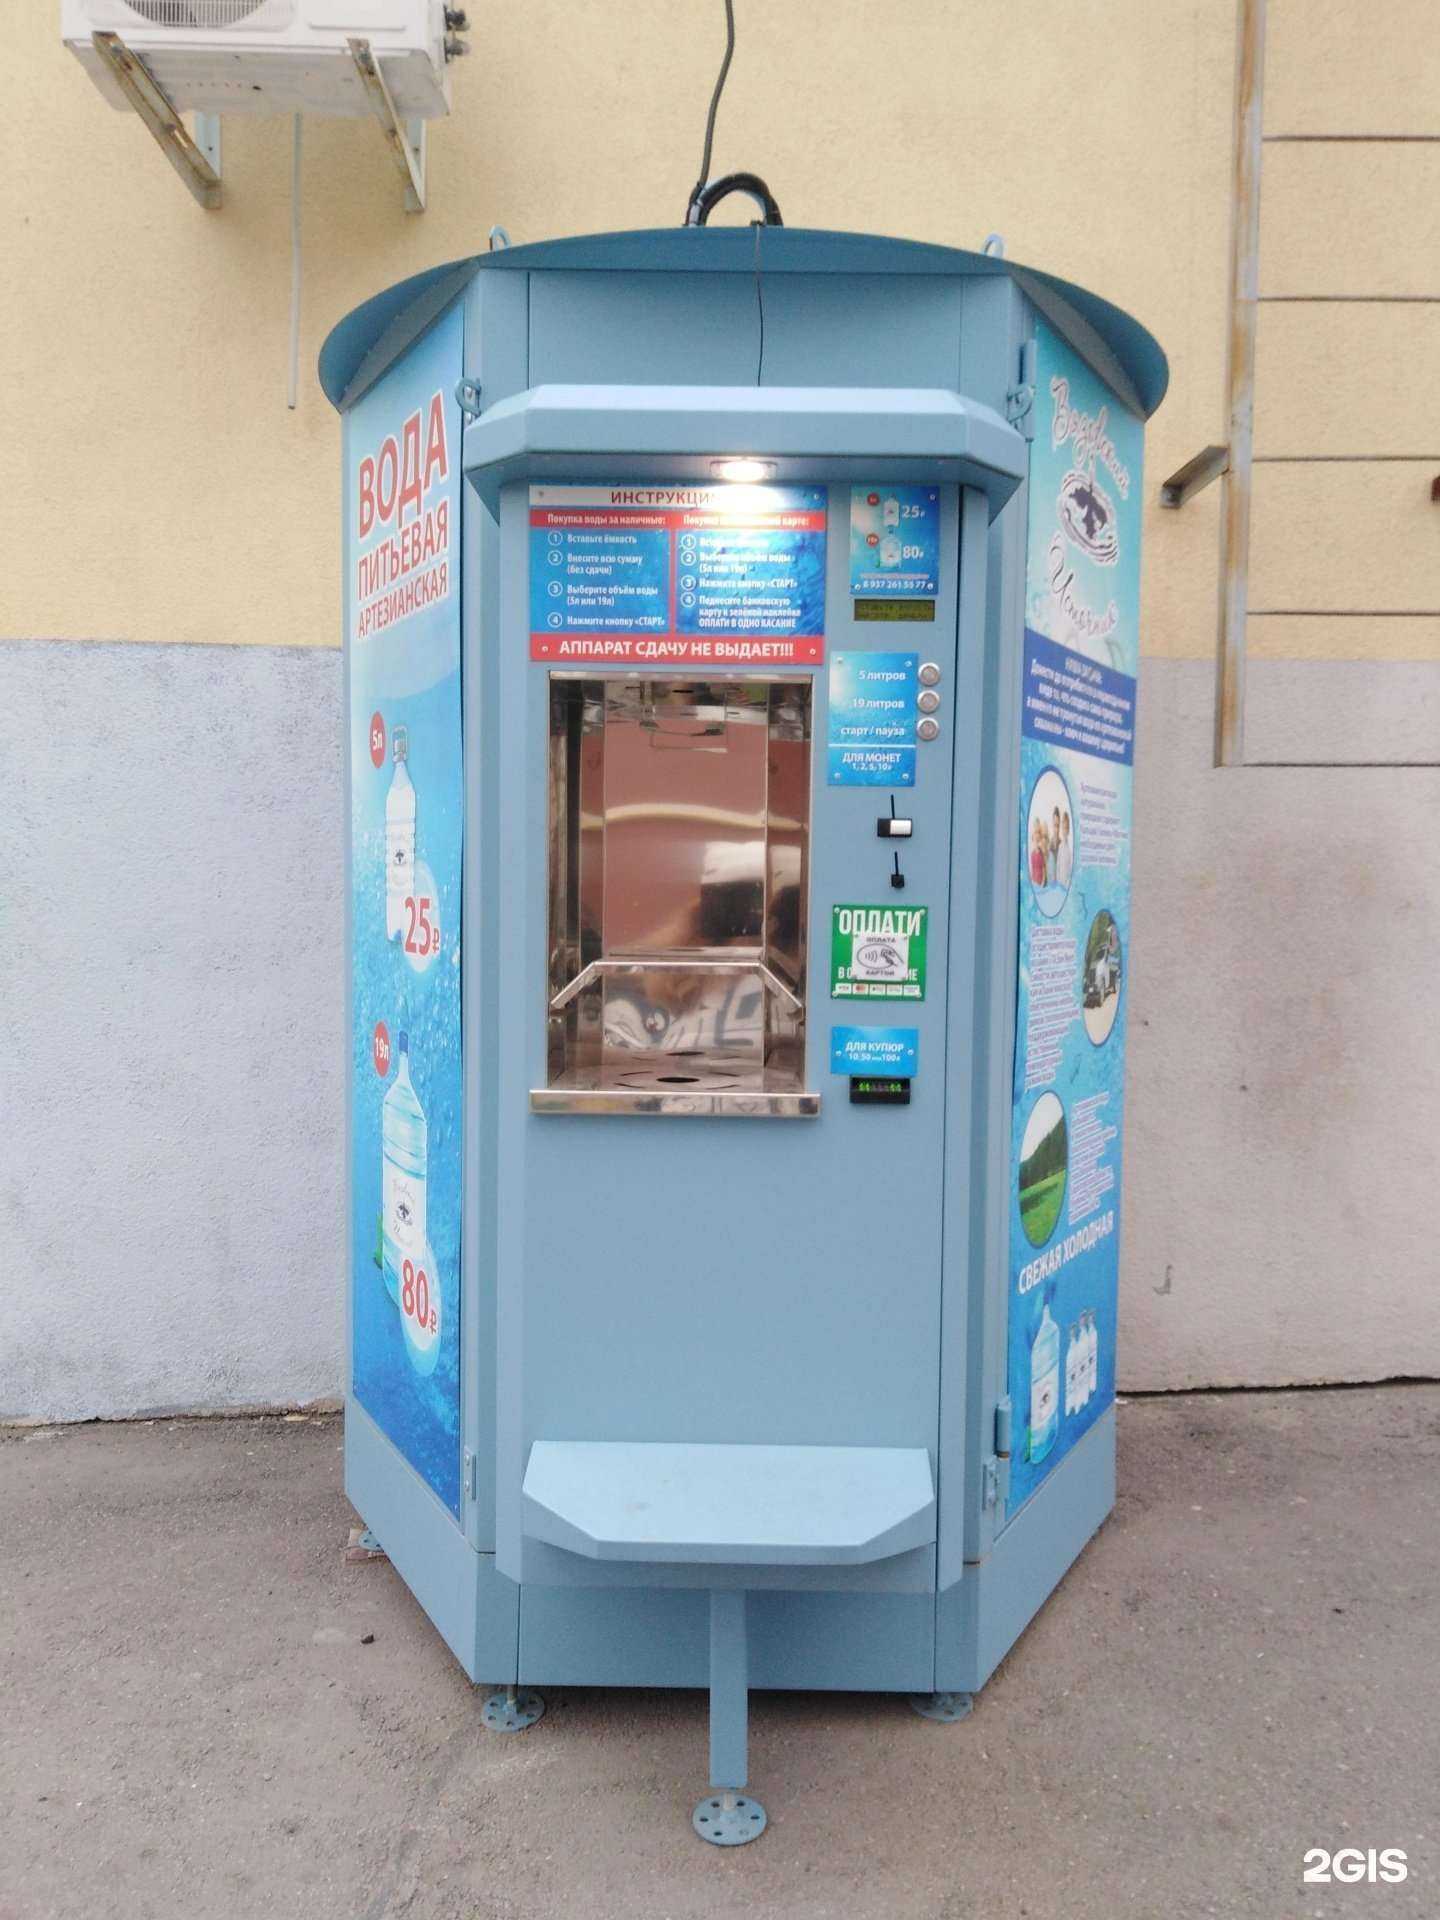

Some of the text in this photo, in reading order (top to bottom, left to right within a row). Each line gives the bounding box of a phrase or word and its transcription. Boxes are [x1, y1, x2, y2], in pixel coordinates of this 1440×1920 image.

[359, 392, 448, 540] ВОДА
[611, 490, 717, 507] ИНСТРУКЦИ
[547, 513, 583, 525] Покупка
[584, 515, 608, 526] воды
[609, 516, 619, 525] за
[358, 500, 448, 601] ПИТЬЕВАЯ
[617, 554, 643, 567] сумму
[567, 565, 613, 577] (без сдачи)
[567, 584, 607, 596] Выберите
[608, 585, 635, 595] объём
[636, 586, 659, 596] воды
[358, 561, 448, 639] АРТЕЗИАНСКАЯ
[567, 596, 580, 607] (5л
[567, 615, 603, 626] Нажмите
[604, 616, 634, 628] кнопку
[634, 615, 665, 626] «СТАРТ»
[560, 640, 794, 660] АППАРАТ СДАЧУ НЕ ВЫДАЕТ!!!
[859, 670, 906, 683] 5 литров
[853, 698, 905, 711] 19 литров
[841, 726, 869, 737] старт
[876, 727, 905, 738] пауза
[373, 731, 383, 750] 5л
[842, 752, 902, 764] ДЛЯ МОНЕТ
[838, 909, 921, 937] ОПЛАТИ
[845, 1041, 904, 1053] ДЛЯ КУПЮР
[1019, 1211, 1114, 1295] СВЕЖАЯ ХОЛОДНАЯ
